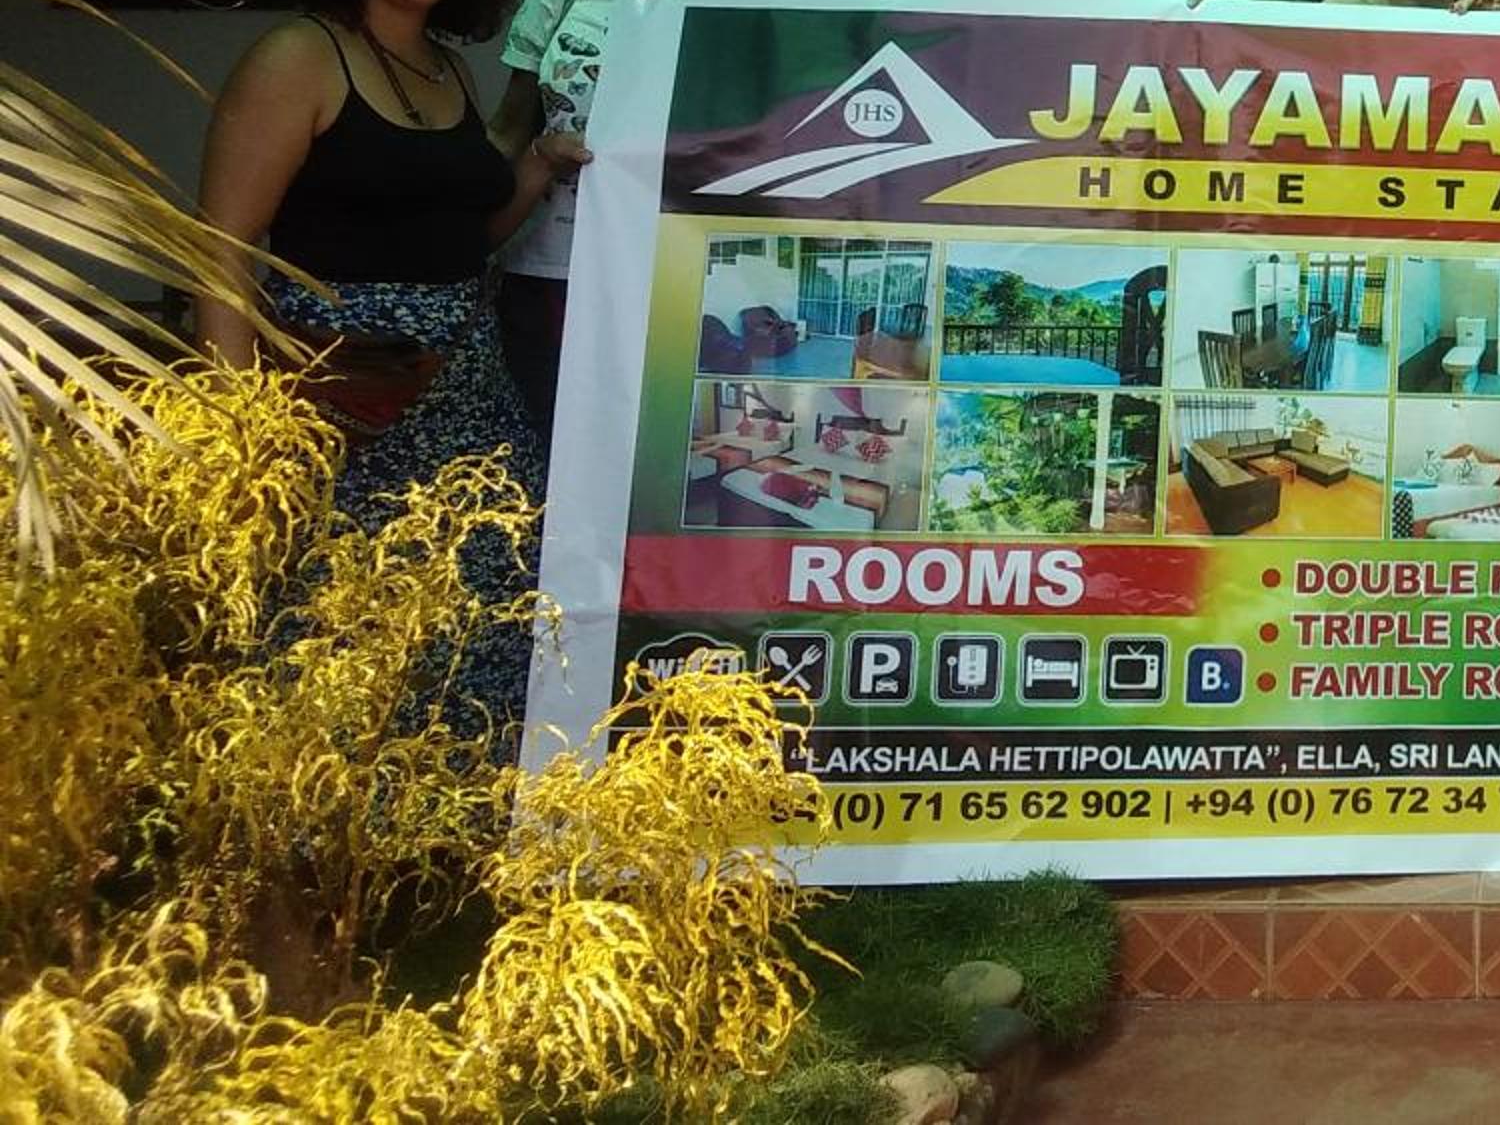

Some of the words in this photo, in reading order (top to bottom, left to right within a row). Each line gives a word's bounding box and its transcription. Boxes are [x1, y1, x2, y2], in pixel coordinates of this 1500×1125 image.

[849, 102, 897, 125] JHS
[1079, 166, 1305, 205] HOME
[788, 546, 1085, 607] ROOMS
[1294, 560, 1477, 597] DOUBLE
[1292, 611, 1451, 648] TRIPLE
[1290, 663, 1454, 700] FAMILY
[1297, 743, 1381, 773] ELLA,
[1389, 743, 1439, 768] SRI
[833, 792, 885, 830] (0)
[900, 792, 943, 821] 71
[960, 791, 1008, 821] 65
[1021, 790, 1068, 820] 62
[1081, 789, 1151, 819] 902
[1186, 788, 1255, 817] +94
[1267, 788, 1315, 824] (0)
[1329, 787, 1373, 815] 76
[1385, 786, 1430, 814] 72
[1442, 786, 1488, 814] 34
